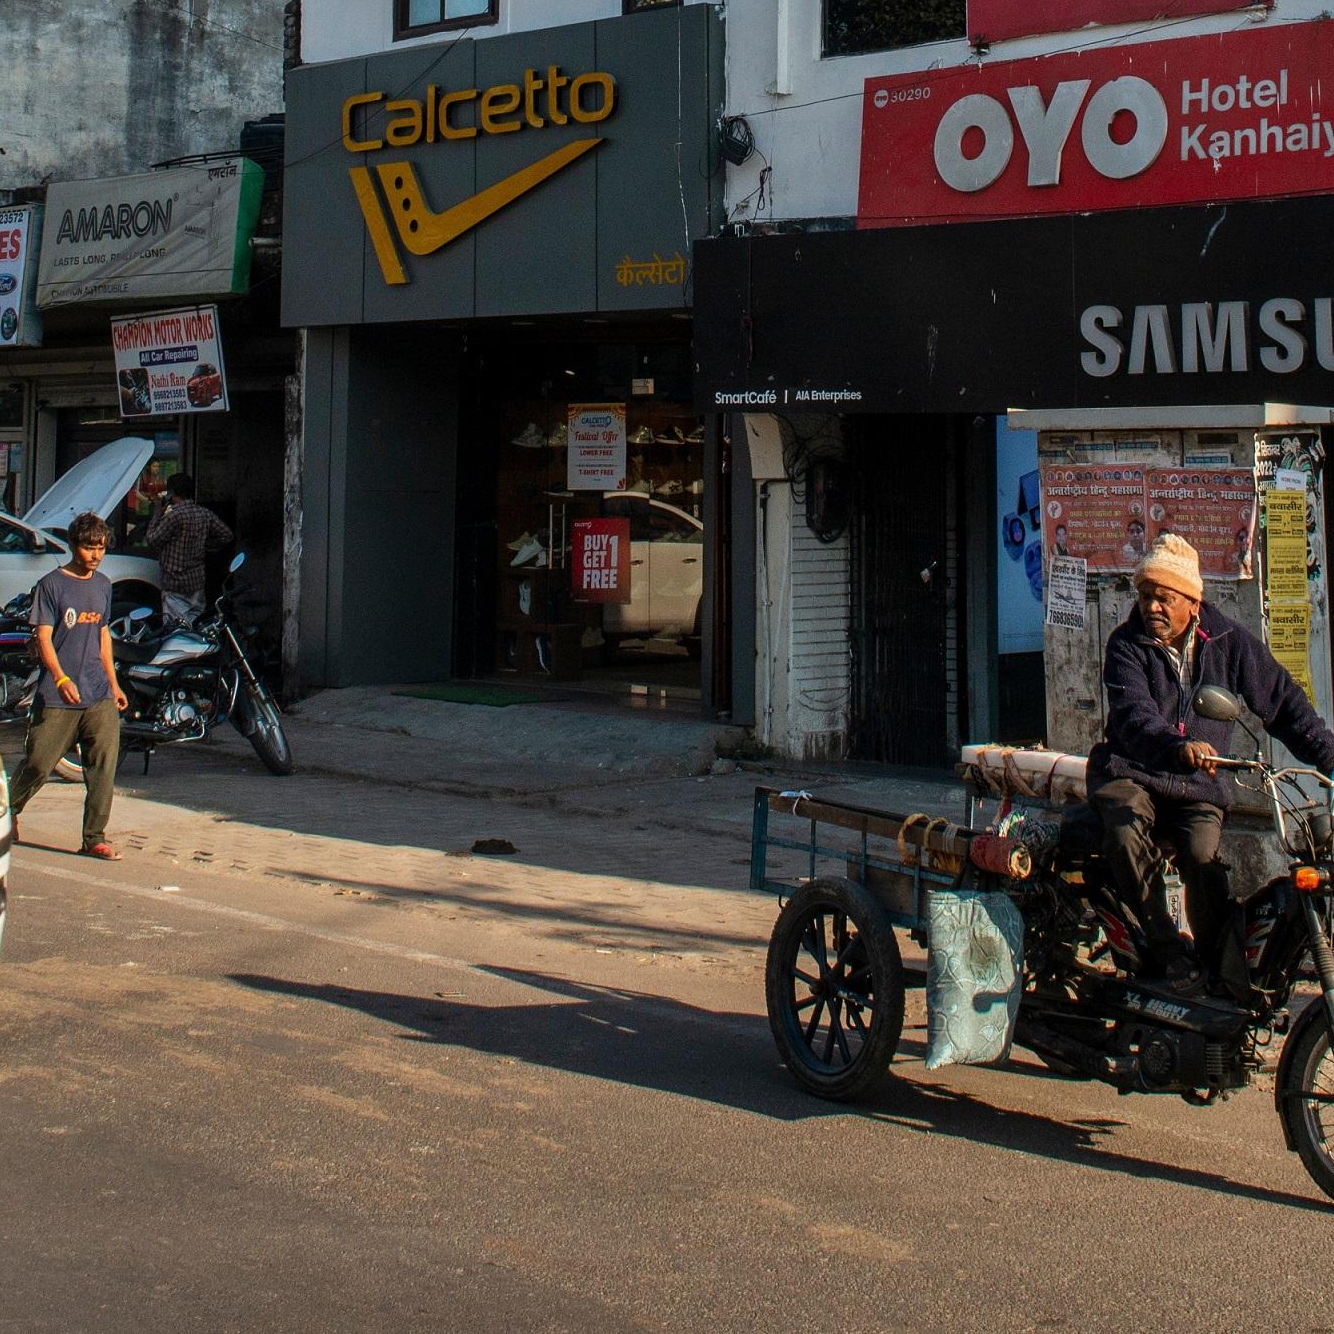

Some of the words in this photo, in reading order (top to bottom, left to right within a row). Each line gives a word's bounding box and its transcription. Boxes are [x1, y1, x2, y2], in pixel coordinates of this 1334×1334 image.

[890, 86, 931, 103] 30290
[1180, 68, 1288, 116] Hotel
[342, 66, 618, 153] Calcetto
[932, 74, 1169, 194] OYO
[56, 198, 173, 245] AMARON
[53, 255, 80, 267] LASTS
[113, 321, 153, 352] CHAMPION
[153, 317, 184, 345] MOTOR
[183, 313, 214, 343] WORKS
[140, 353, 150, 363] All
[151, 351, 163, 362] Car
[164, 348, 199, 363] Repairing
[169, 371, 186, 387] Ram
[715, 389, 778, 405] SmartCafé
[795, 389, 810, 402] AIA
[811, 388, 863, 404] Enterprises
[601, 430, 620, 444] Offer
[582, 550, 607, 568] GET
[583, 534, 609, 551] BUY
[609, 534, 619, 568] 1
[582, 568, 618, 589] FREE
